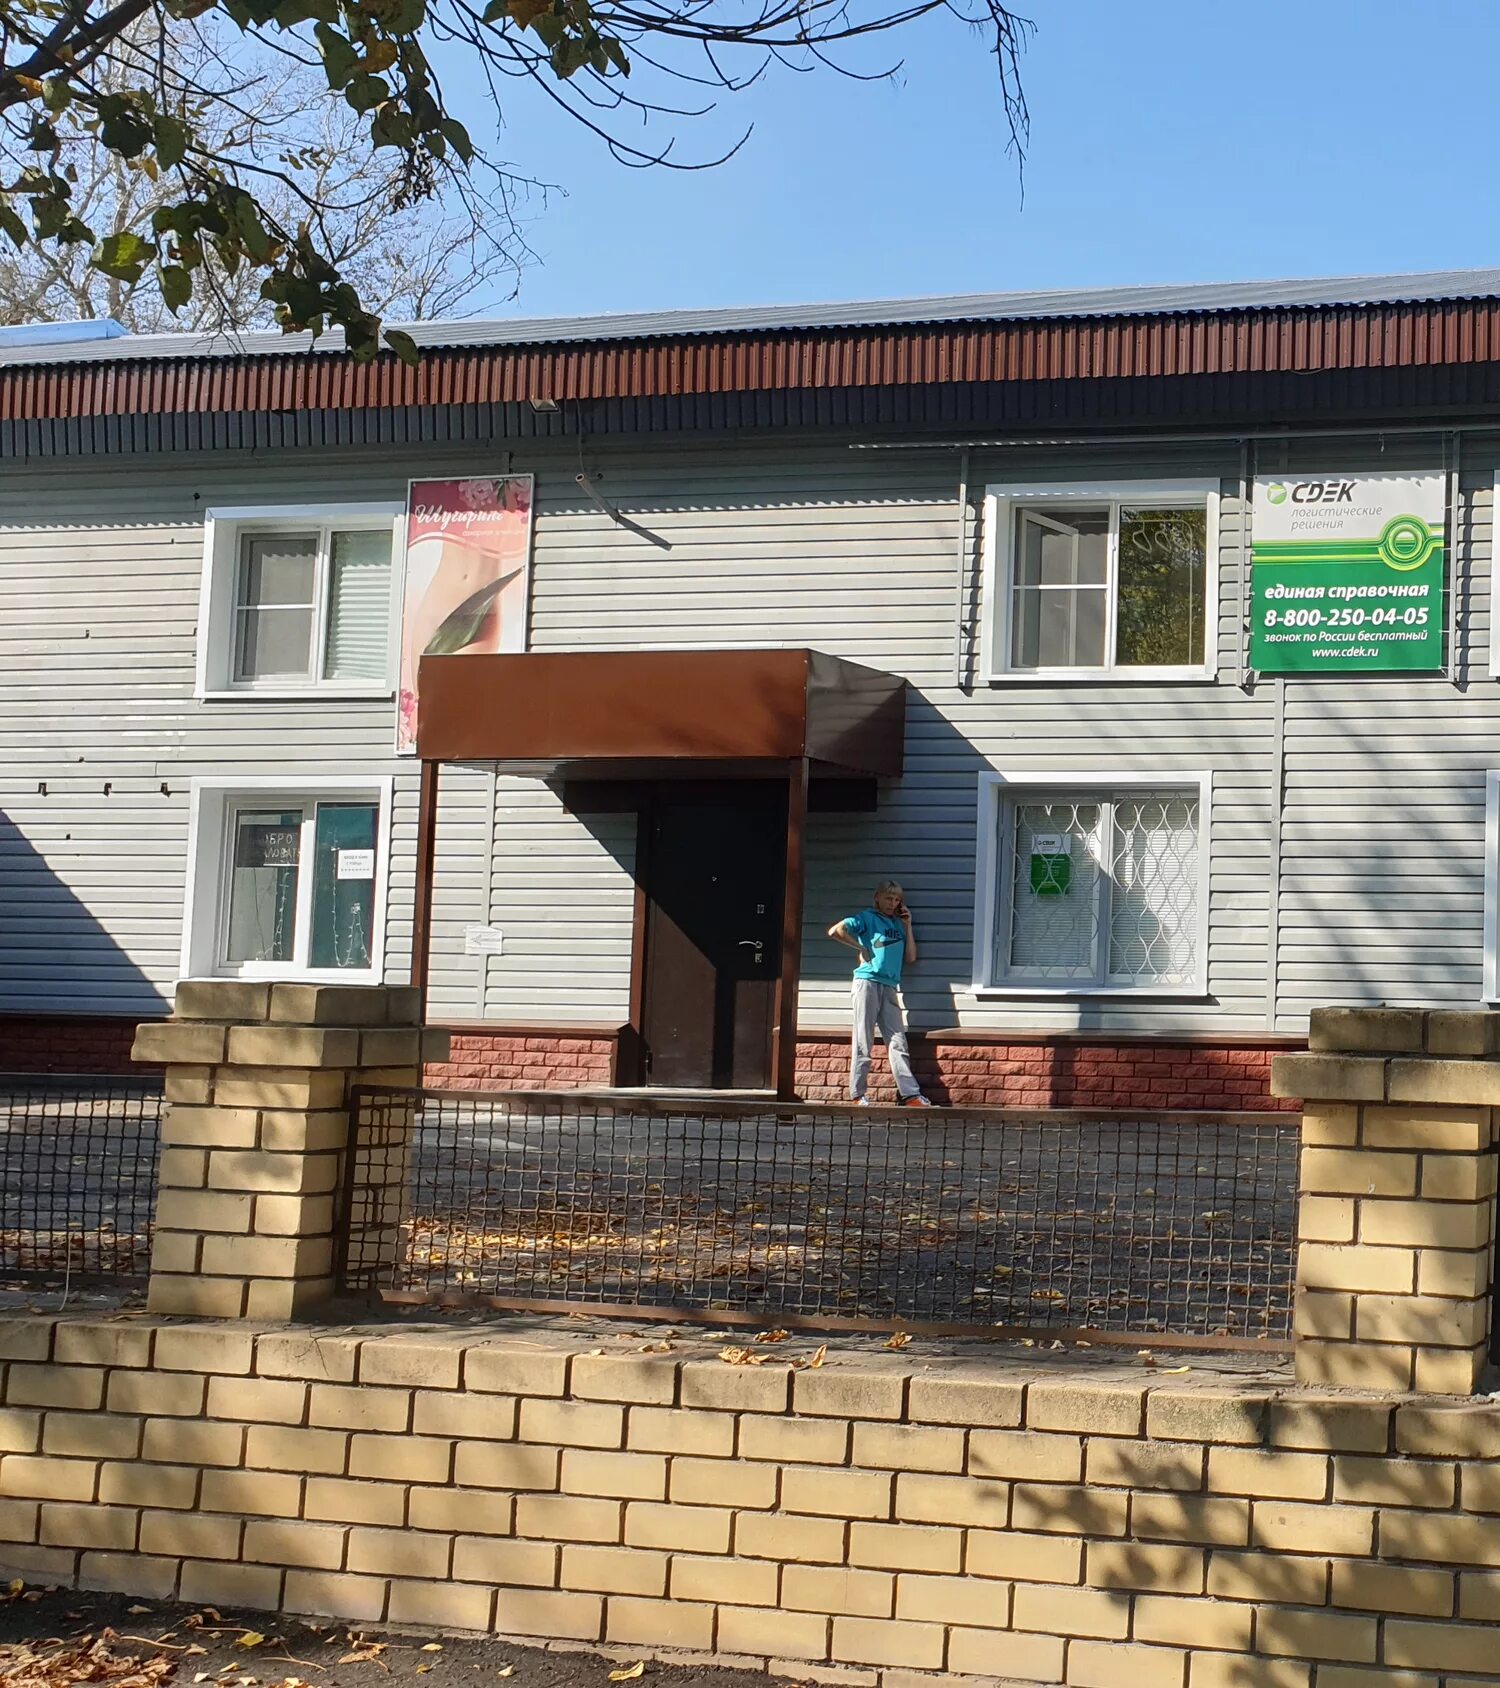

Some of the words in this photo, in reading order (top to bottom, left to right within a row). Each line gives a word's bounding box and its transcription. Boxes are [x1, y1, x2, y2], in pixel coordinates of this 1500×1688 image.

[1291, 482, 1358, 504] CDEK
[1291, 506, 1383, 518] логистические
[1290, 520, 1344, 532] решения
[1264, 584, 1325, 599] единая
[1328, 584, 1430, 601] справочная
[1264, 607, 1430, 627] 8-800-250-04-05
[1264, 632, 1301, 642] звонок
[1303, 633, 1317, 642] по
[1318, 631, 1356, 642] России
[1357, 629, 1428, 642] бесплатный
[1312, 646, 1379, 657] www.cdek.ru
